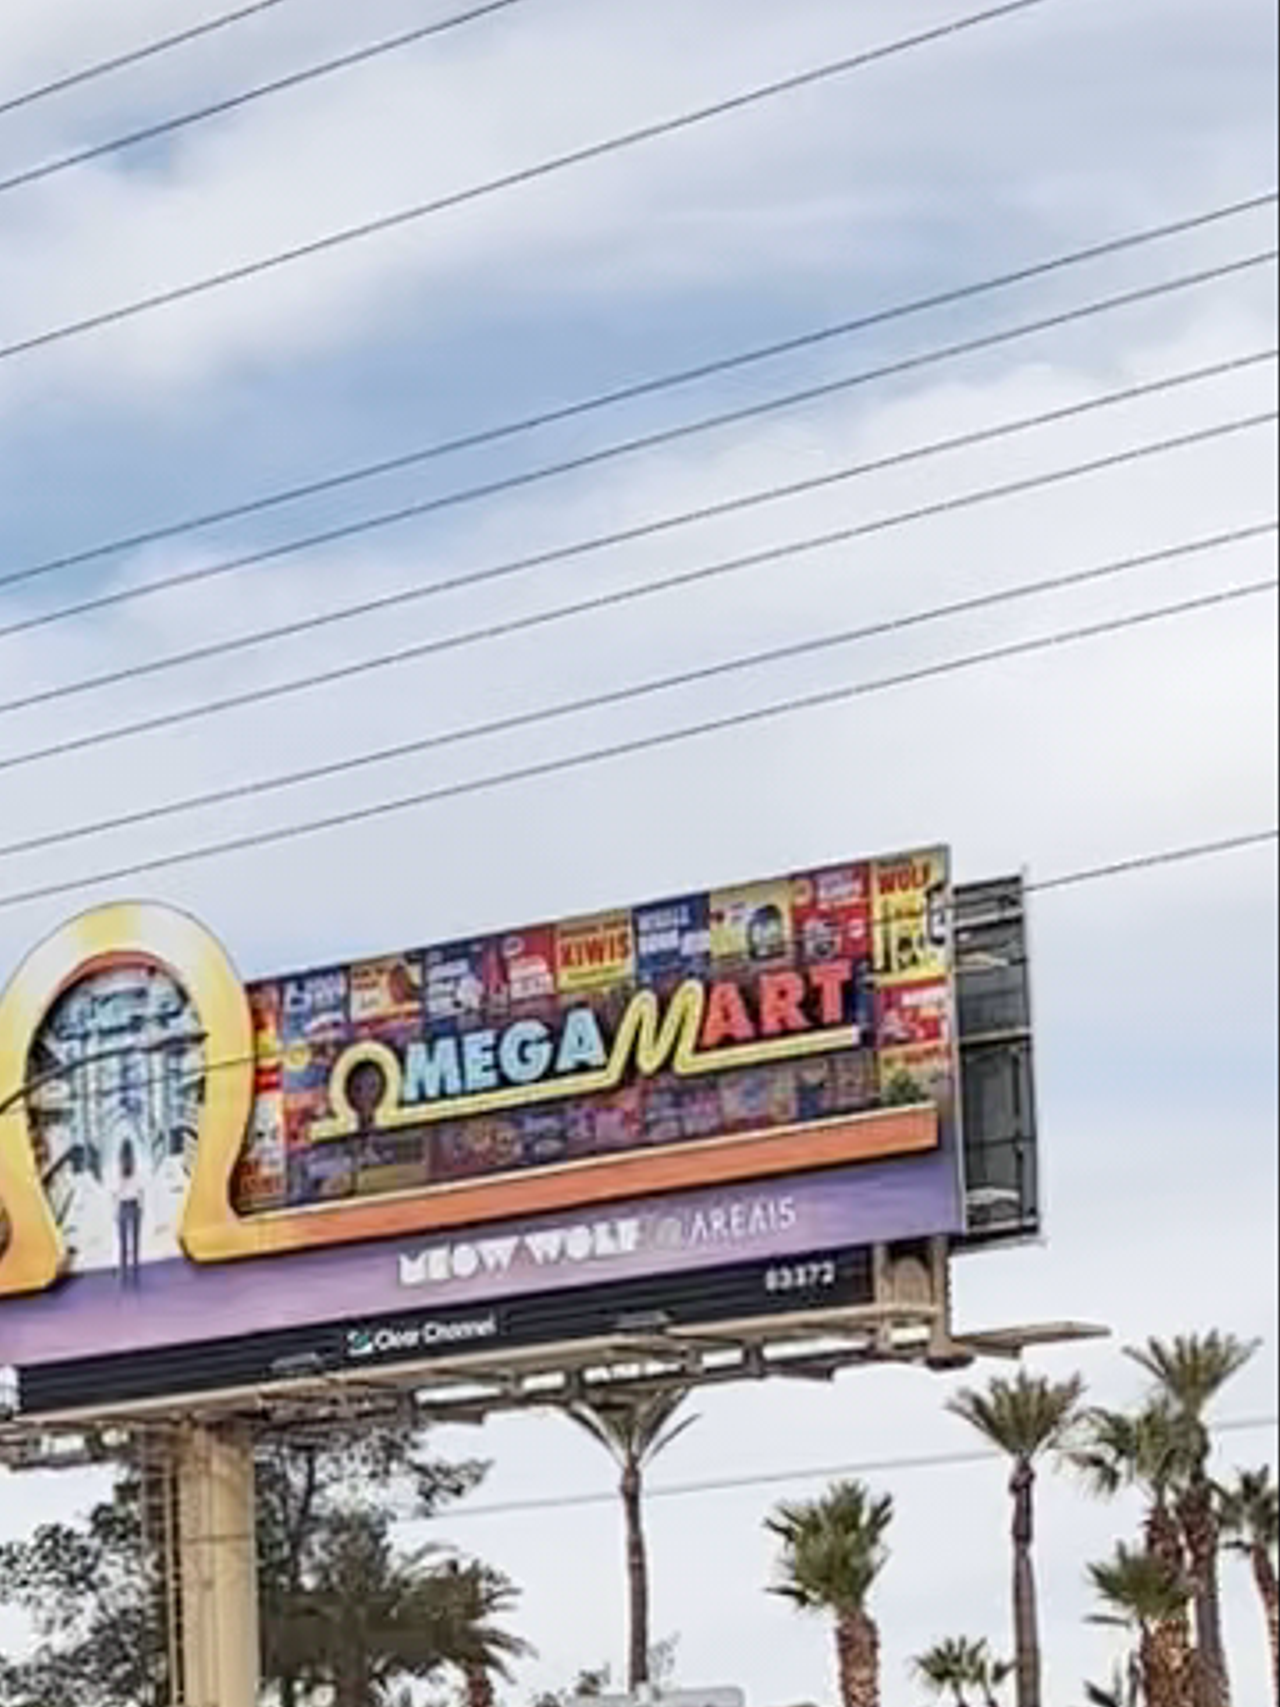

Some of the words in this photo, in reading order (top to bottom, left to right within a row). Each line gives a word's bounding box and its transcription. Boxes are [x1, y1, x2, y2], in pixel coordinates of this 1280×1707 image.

[398, 1235, 519, 1286] MEOW
[525, 1217, 640, 1266] WOLF
[373, 1326, 420, 1351] Clear
[422, 1311, 497, 1344] Channel
